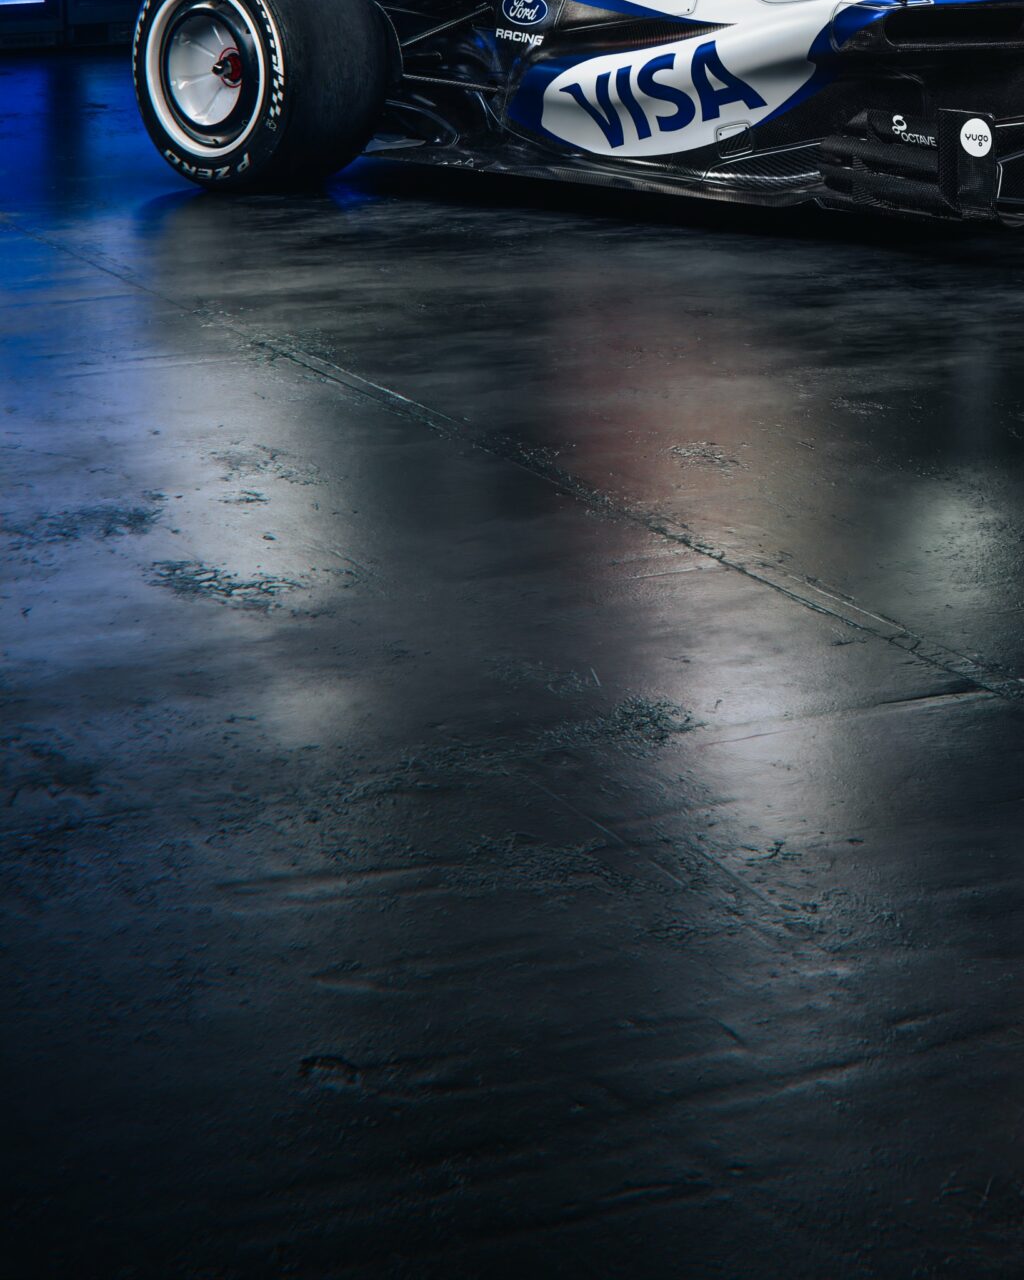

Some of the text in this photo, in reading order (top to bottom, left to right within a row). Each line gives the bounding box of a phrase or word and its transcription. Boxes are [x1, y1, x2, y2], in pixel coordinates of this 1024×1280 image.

[495, 28, 545, 46] RACING
[559, 40, 768, 149] VISA
[900, 132, 938, 148] OCTAVE
[965, 133, 989, 147] yugo
[164, 149, 250, 180] P ZERO
